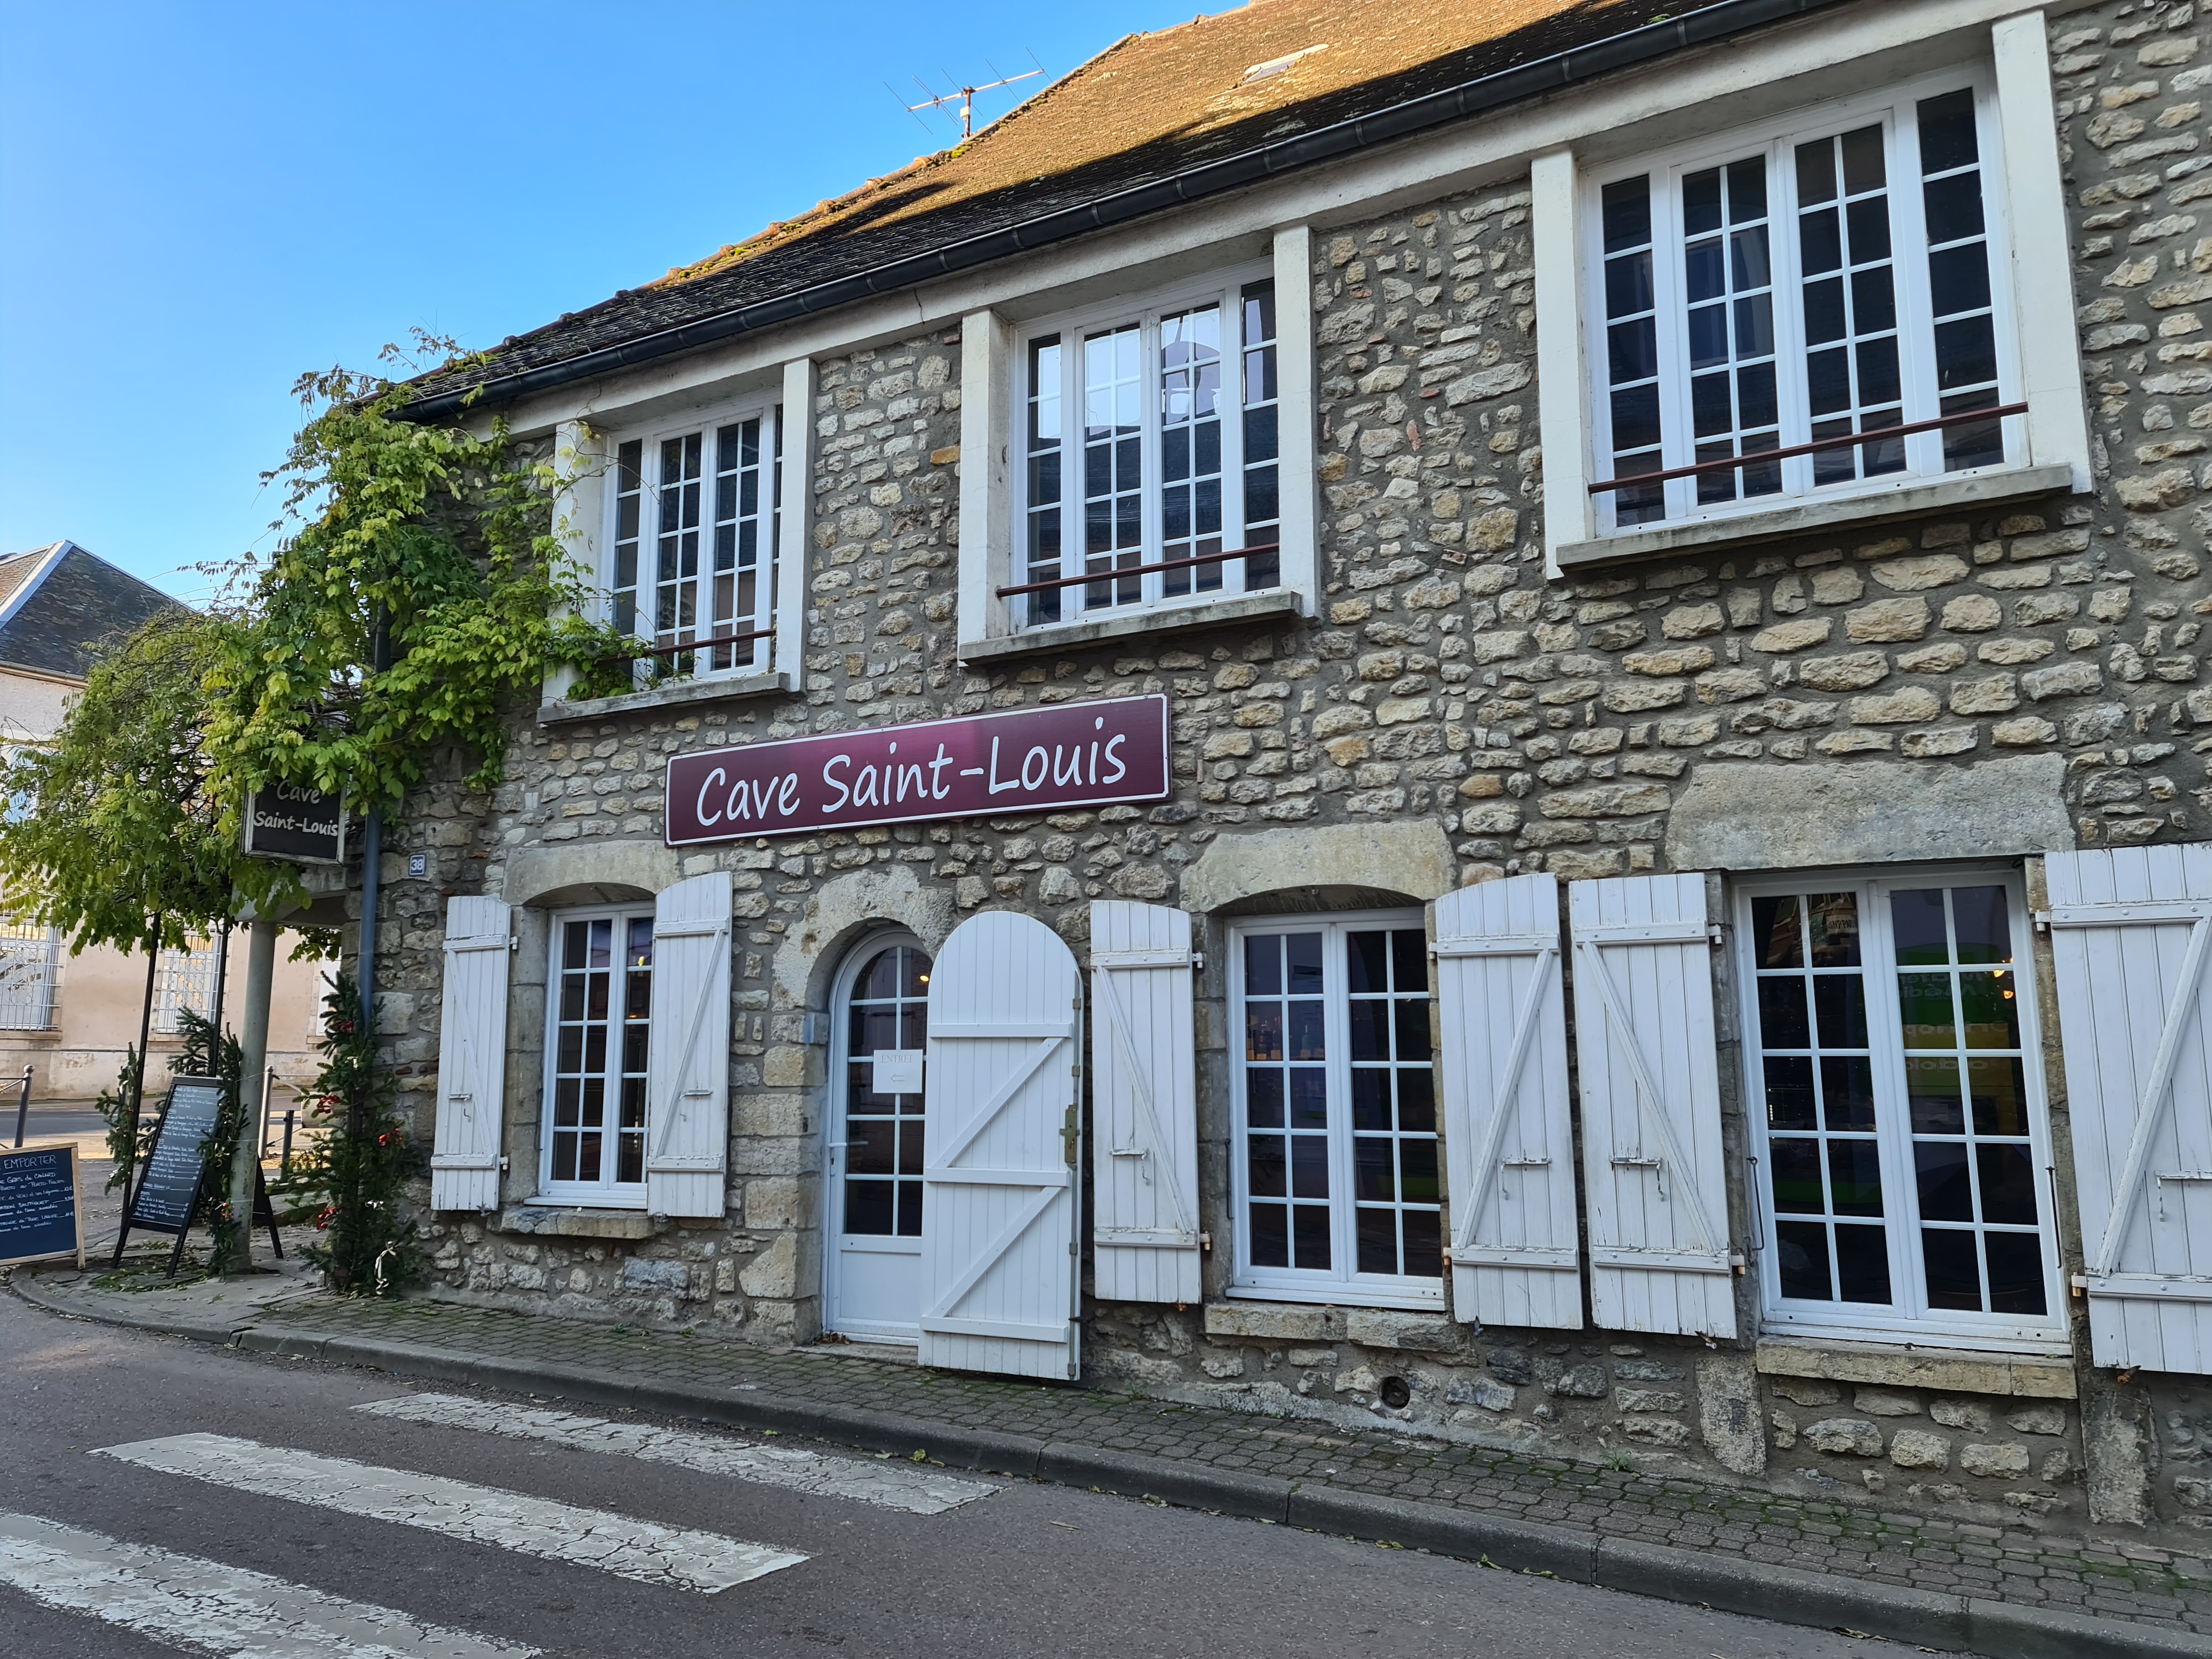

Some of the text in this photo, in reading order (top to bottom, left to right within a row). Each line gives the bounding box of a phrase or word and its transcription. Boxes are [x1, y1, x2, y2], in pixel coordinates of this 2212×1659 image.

[697, 717, 1126, 826] Cave Saint-Louis
[277, 779, 320, 804] Cave
[254, 811, 338, 836] Saint-Louis
[411, 859, 423, 871] 38
[4, 1155, 56, 1169] EMPORTER
